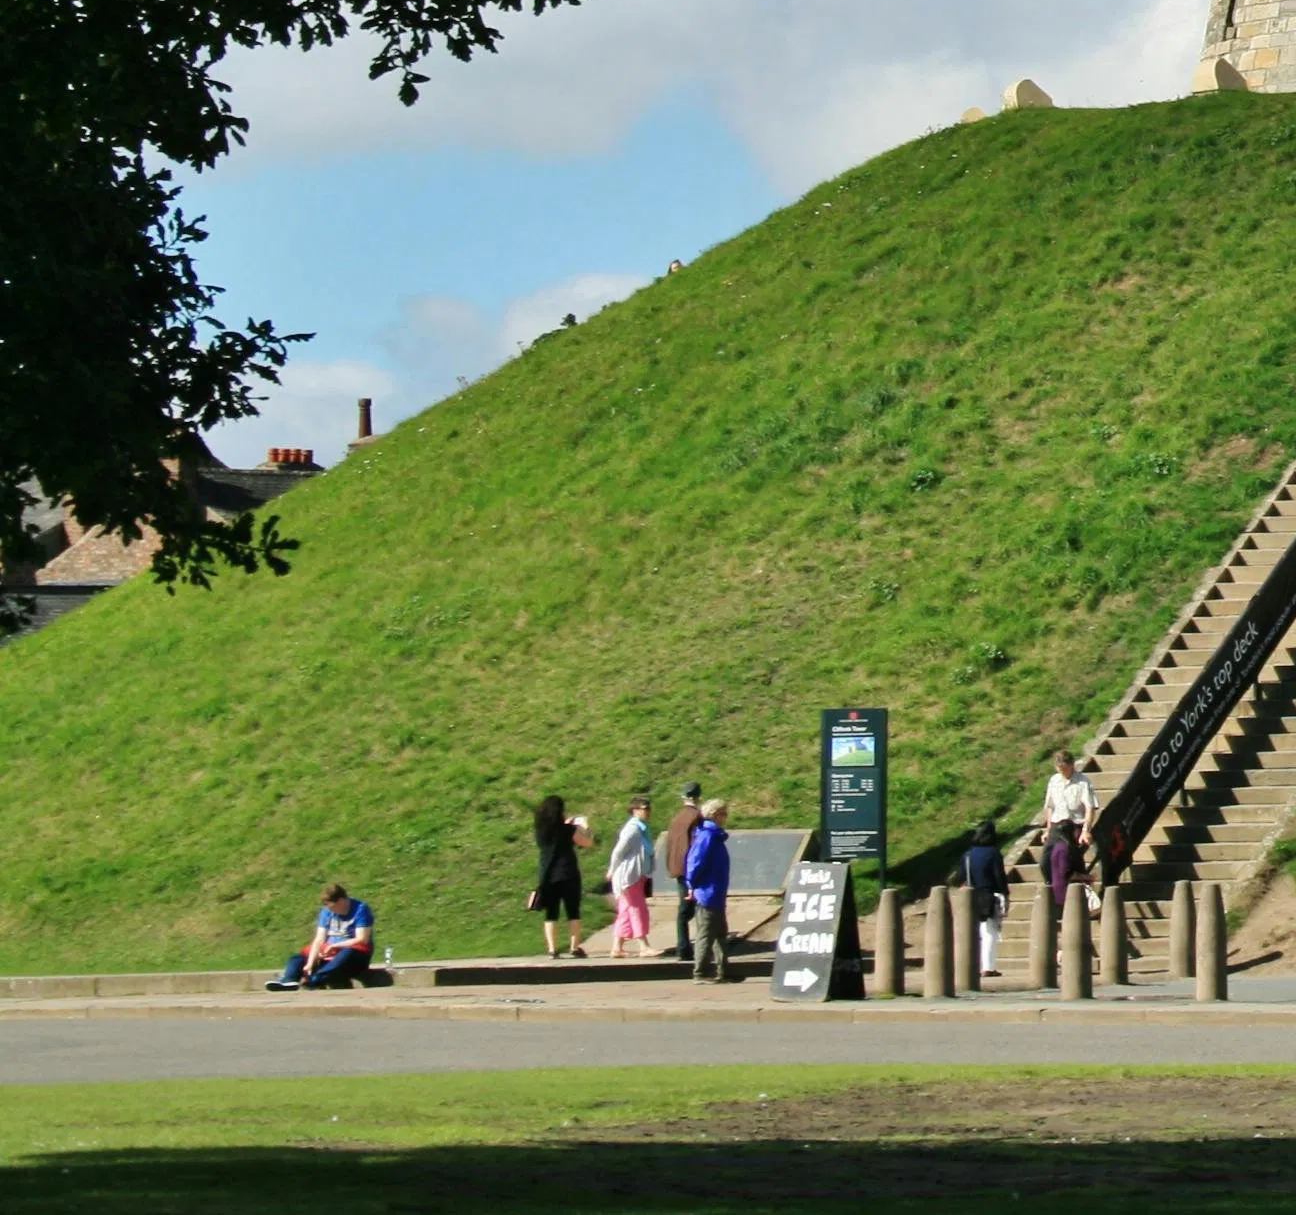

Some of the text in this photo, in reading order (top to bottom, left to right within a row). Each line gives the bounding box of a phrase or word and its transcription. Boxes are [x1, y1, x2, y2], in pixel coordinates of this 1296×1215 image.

[1150, 621, 1259, 778] Go to York's top deck
[787, 893, 837, 922] ICE
